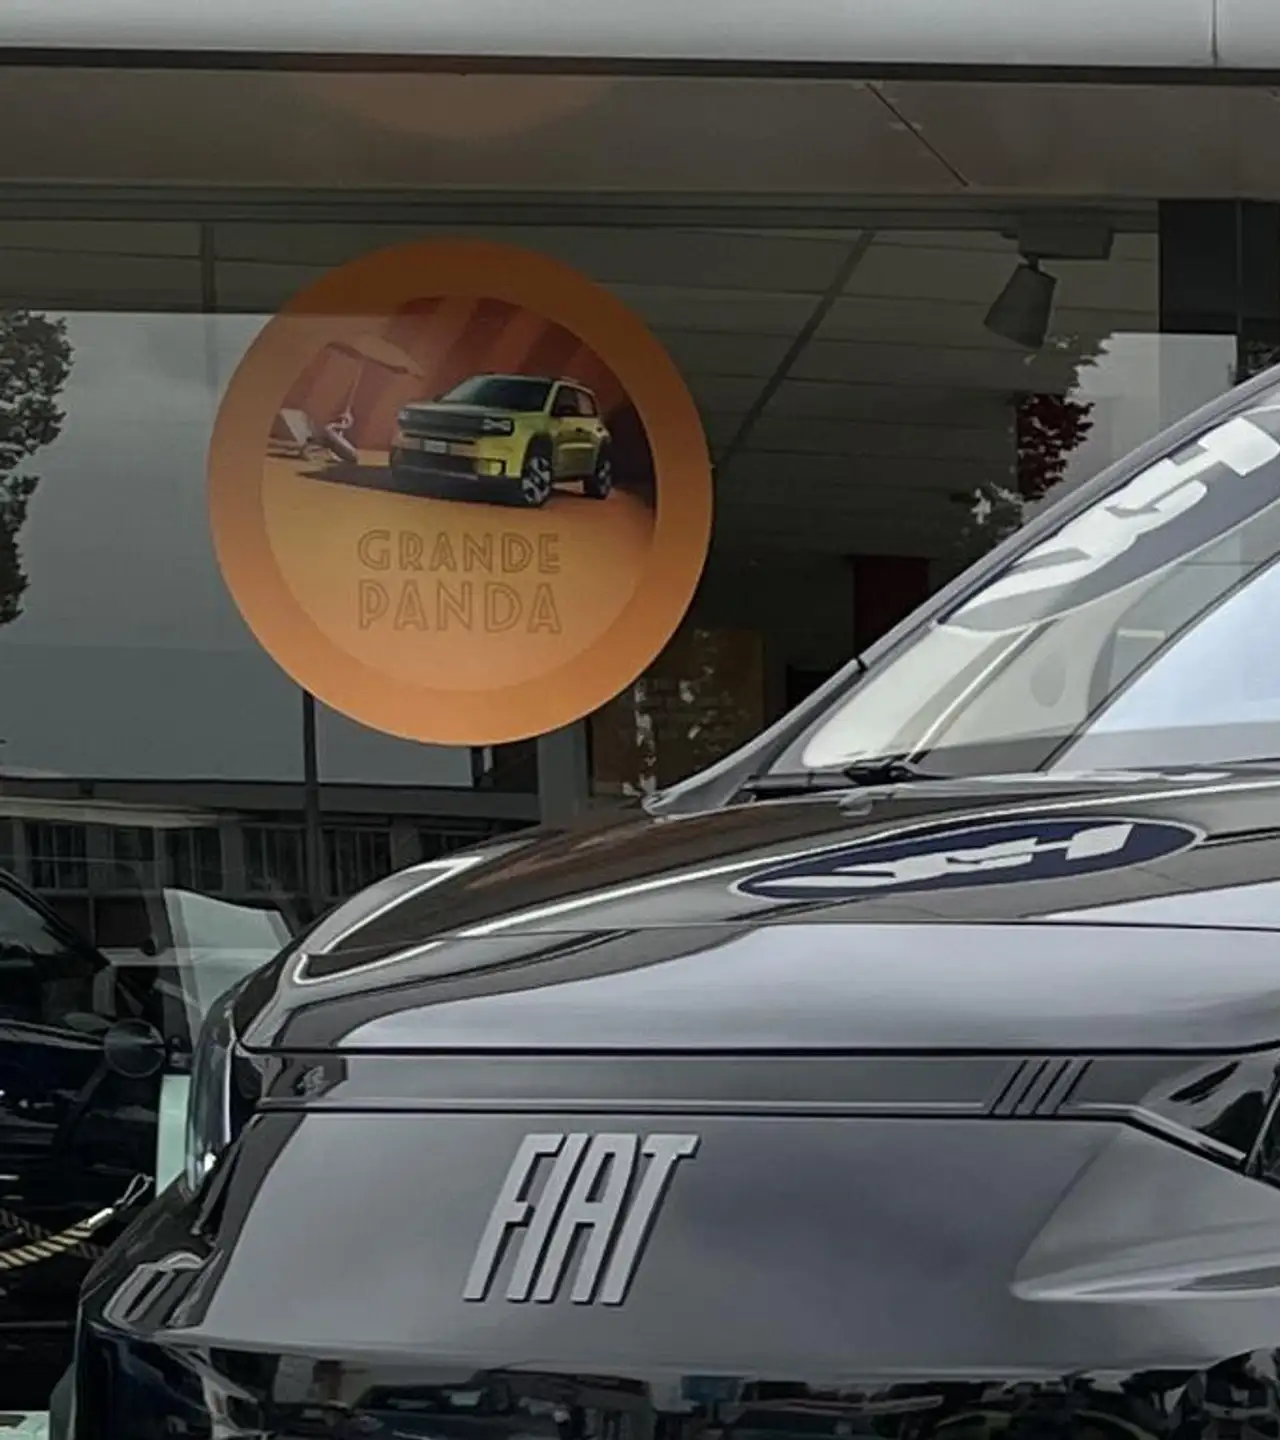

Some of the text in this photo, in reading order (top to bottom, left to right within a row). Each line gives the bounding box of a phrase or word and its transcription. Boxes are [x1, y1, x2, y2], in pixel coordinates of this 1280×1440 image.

[357, 529, 561, 574] GRANDE
[358, 579, 563, 634] PANDA
[462, 1133, 700, 1306] FIAT
